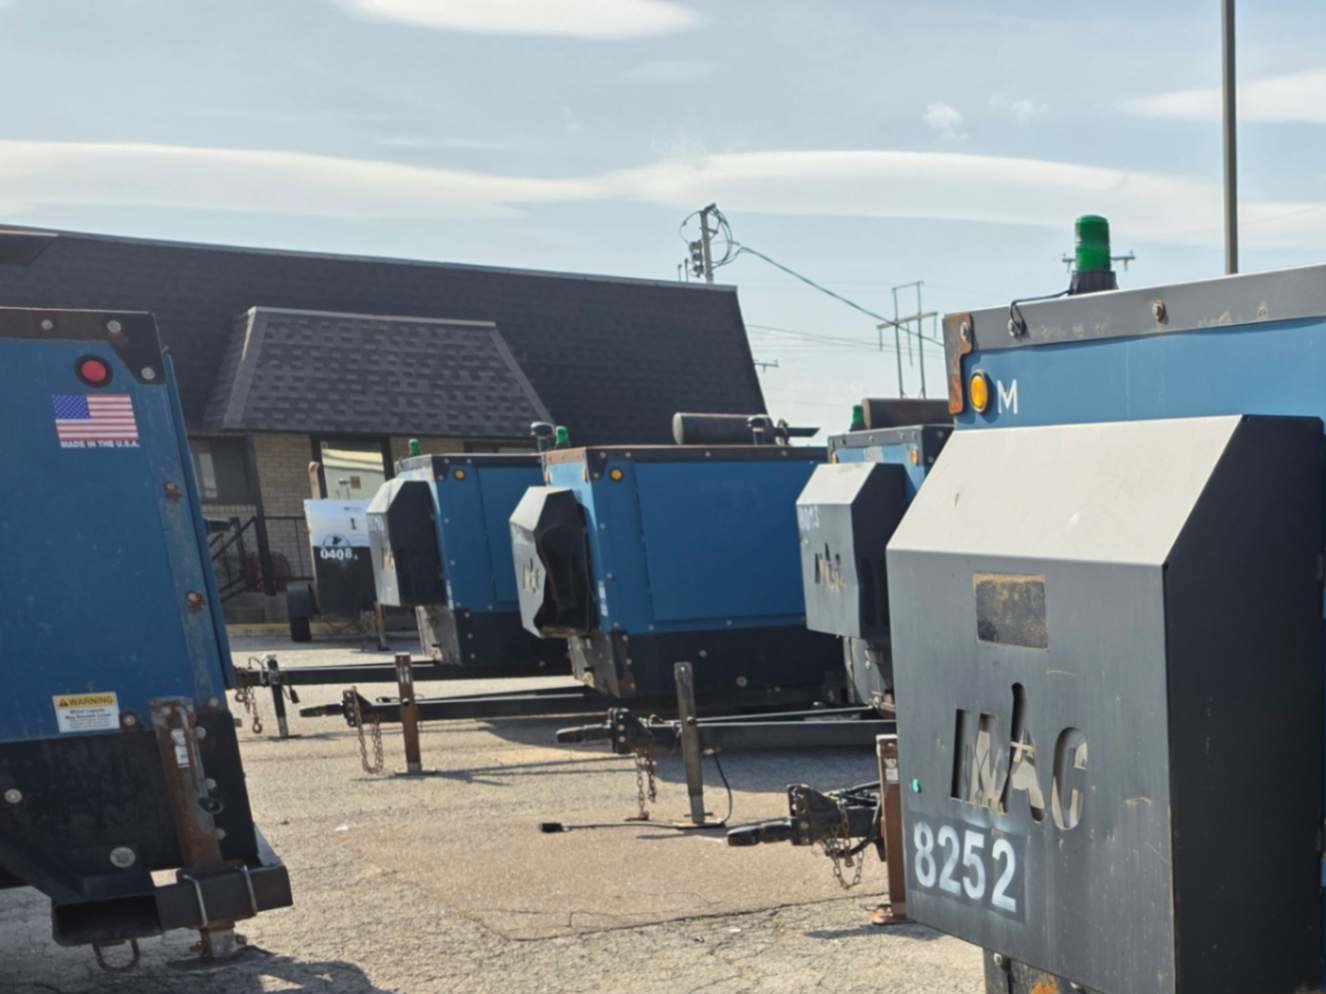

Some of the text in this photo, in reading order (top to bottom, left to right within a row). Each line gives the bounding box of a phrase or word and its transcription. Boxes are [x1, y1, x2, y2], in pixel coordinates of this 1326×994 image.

[996, 378, 1018, 415] M
[61, 440, 85, 448] MADE
[86, 440, 97, 448] IN
[98, 440, 114, 448] THE
[69, 695, 114, 706] WARNING
[950, 682, 1088, 831] MAC
[913, 821, 1017, 913] 8252
